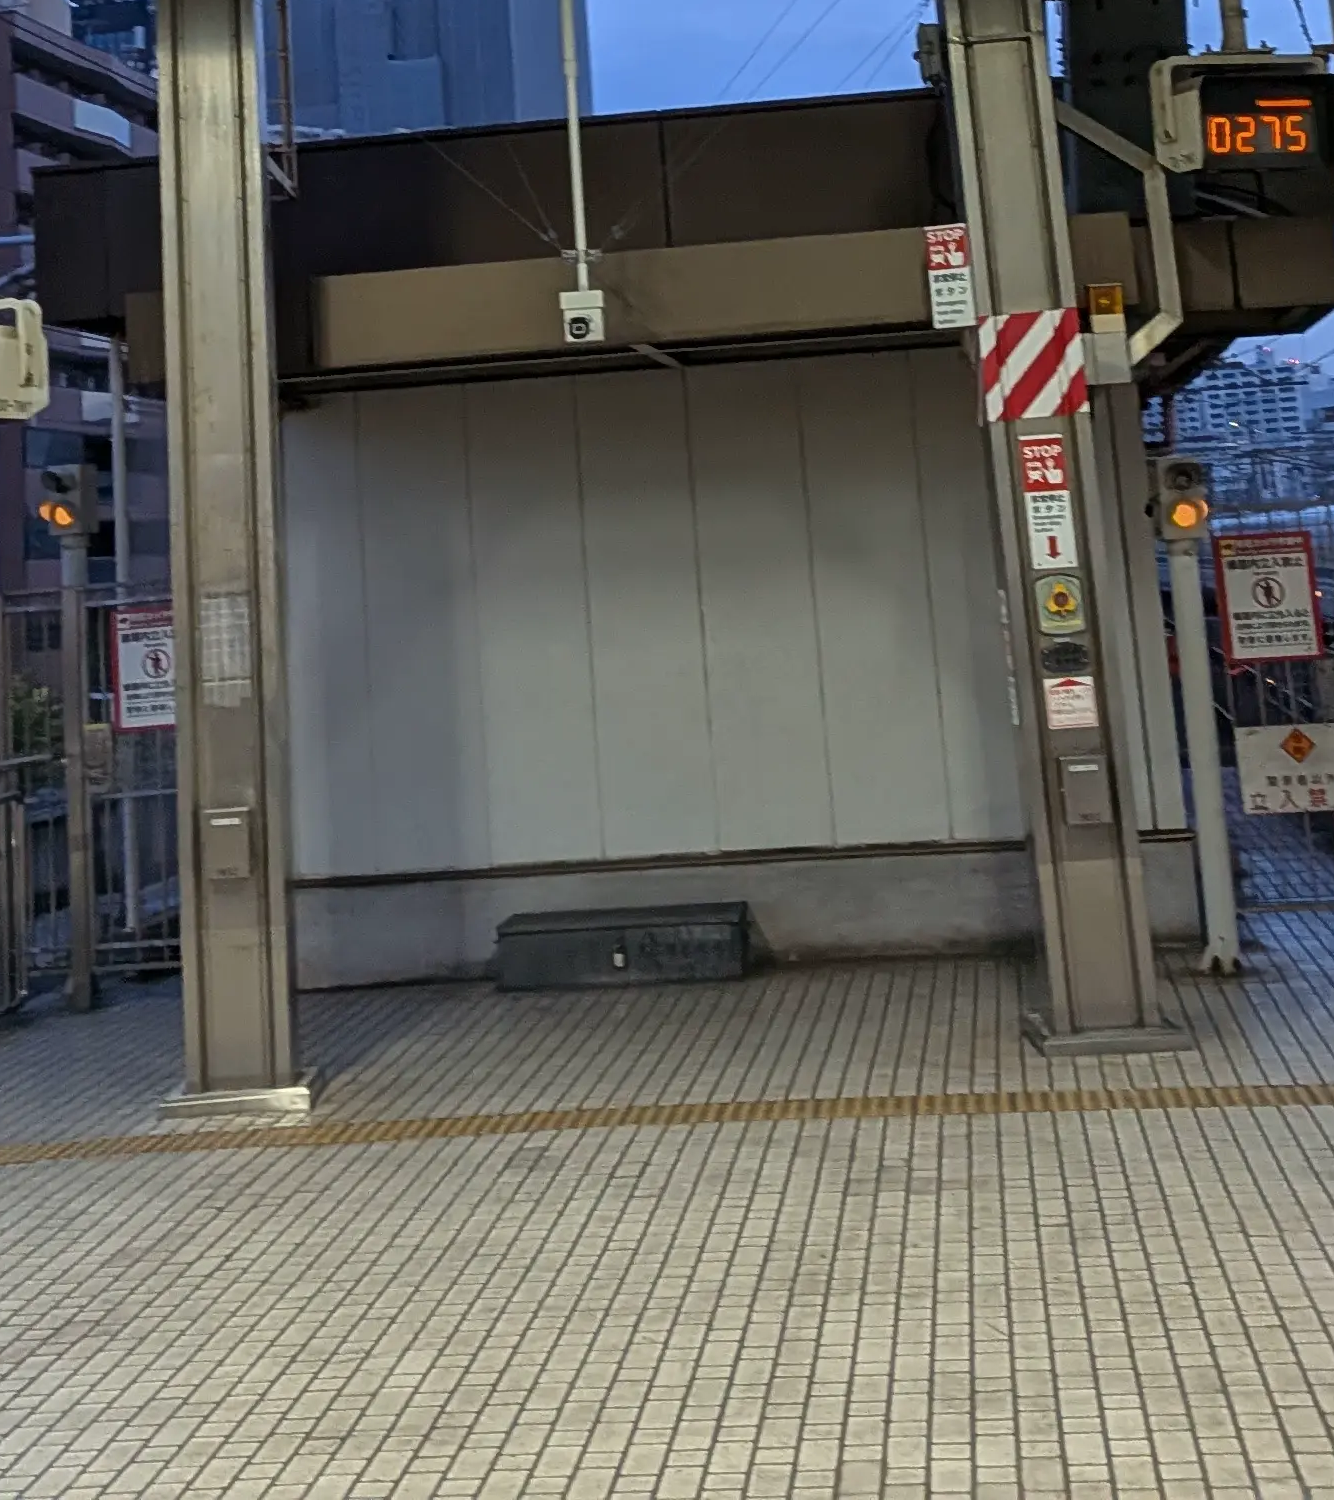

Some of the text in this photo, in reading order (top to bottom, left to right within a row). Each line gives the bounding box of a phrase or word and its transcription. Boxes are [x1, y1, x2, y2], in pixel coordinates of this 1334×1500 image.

[1207, 115, 1307, 153] 0275
[927, 228, 964, 244] STOP
[1022, 444, 1063, 459] STOP
